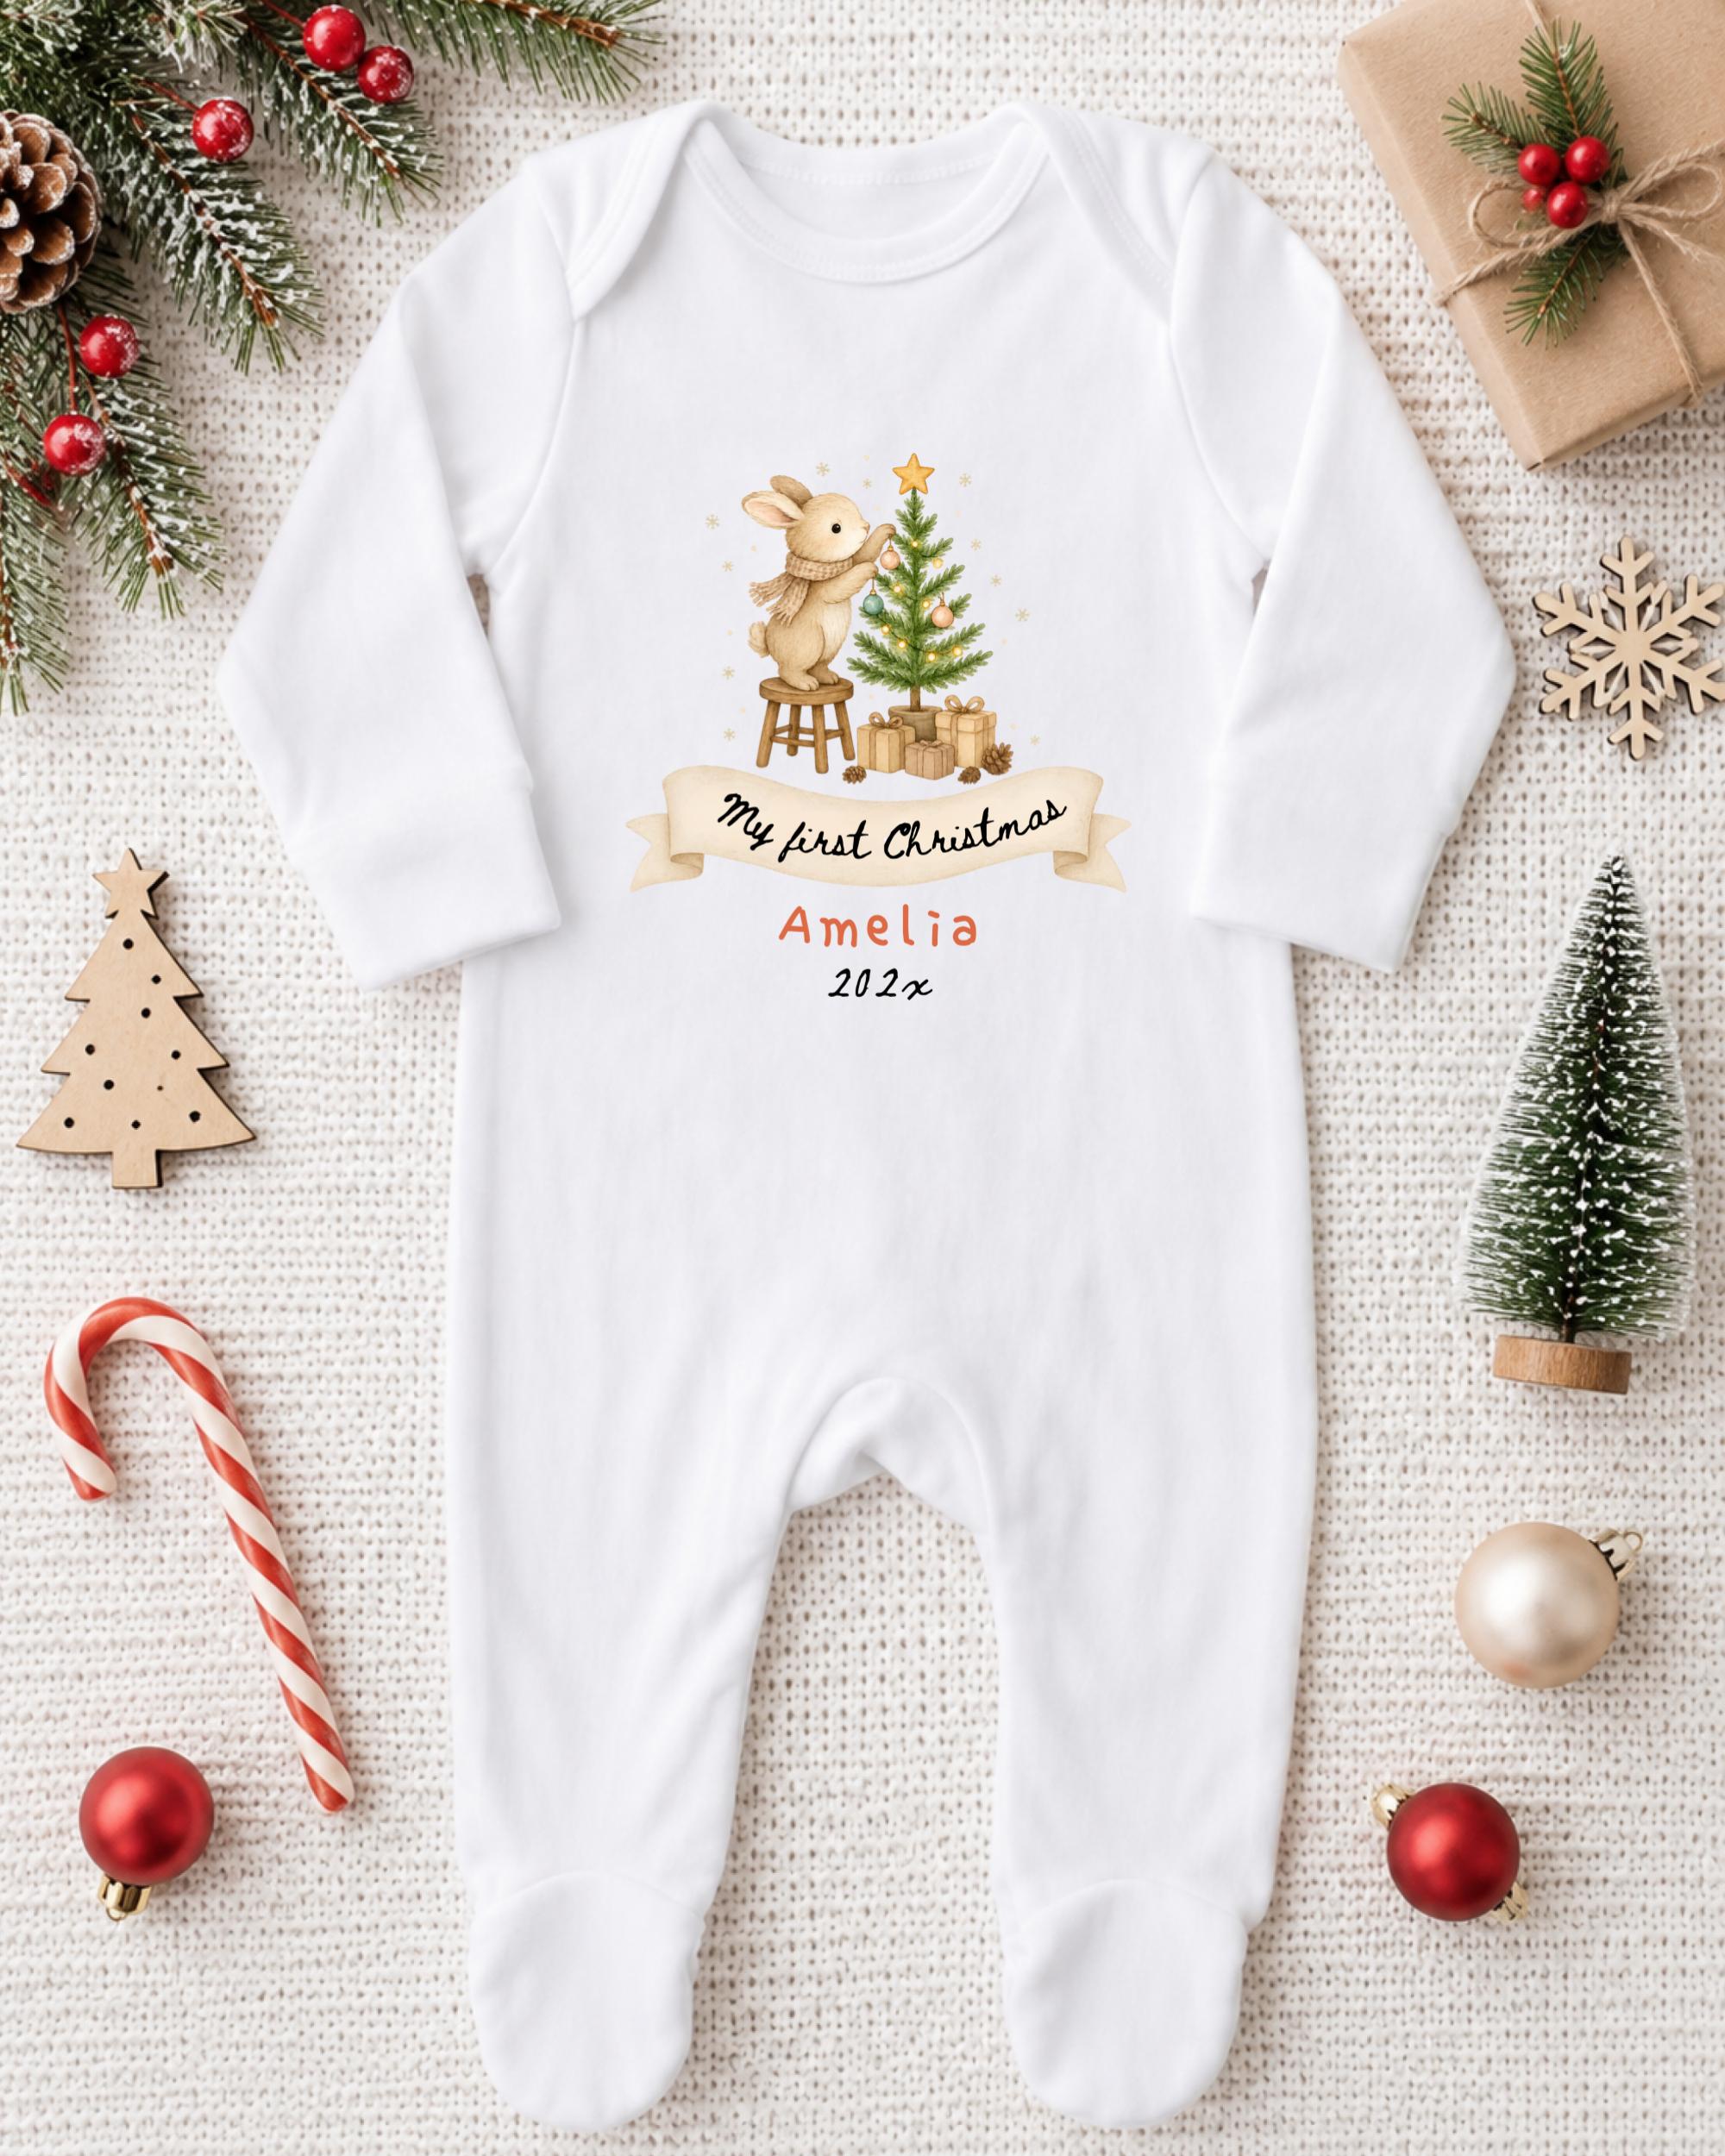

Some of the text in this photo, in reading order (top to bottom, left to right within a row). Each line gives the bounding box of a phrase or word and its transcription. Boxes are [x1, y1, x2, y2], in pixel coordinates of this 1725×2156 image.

[717, 793, 1068, 863] My first Christmas
[778, 903, 978, 949] Amelia
[827, 968, 934, 1001] 202x
